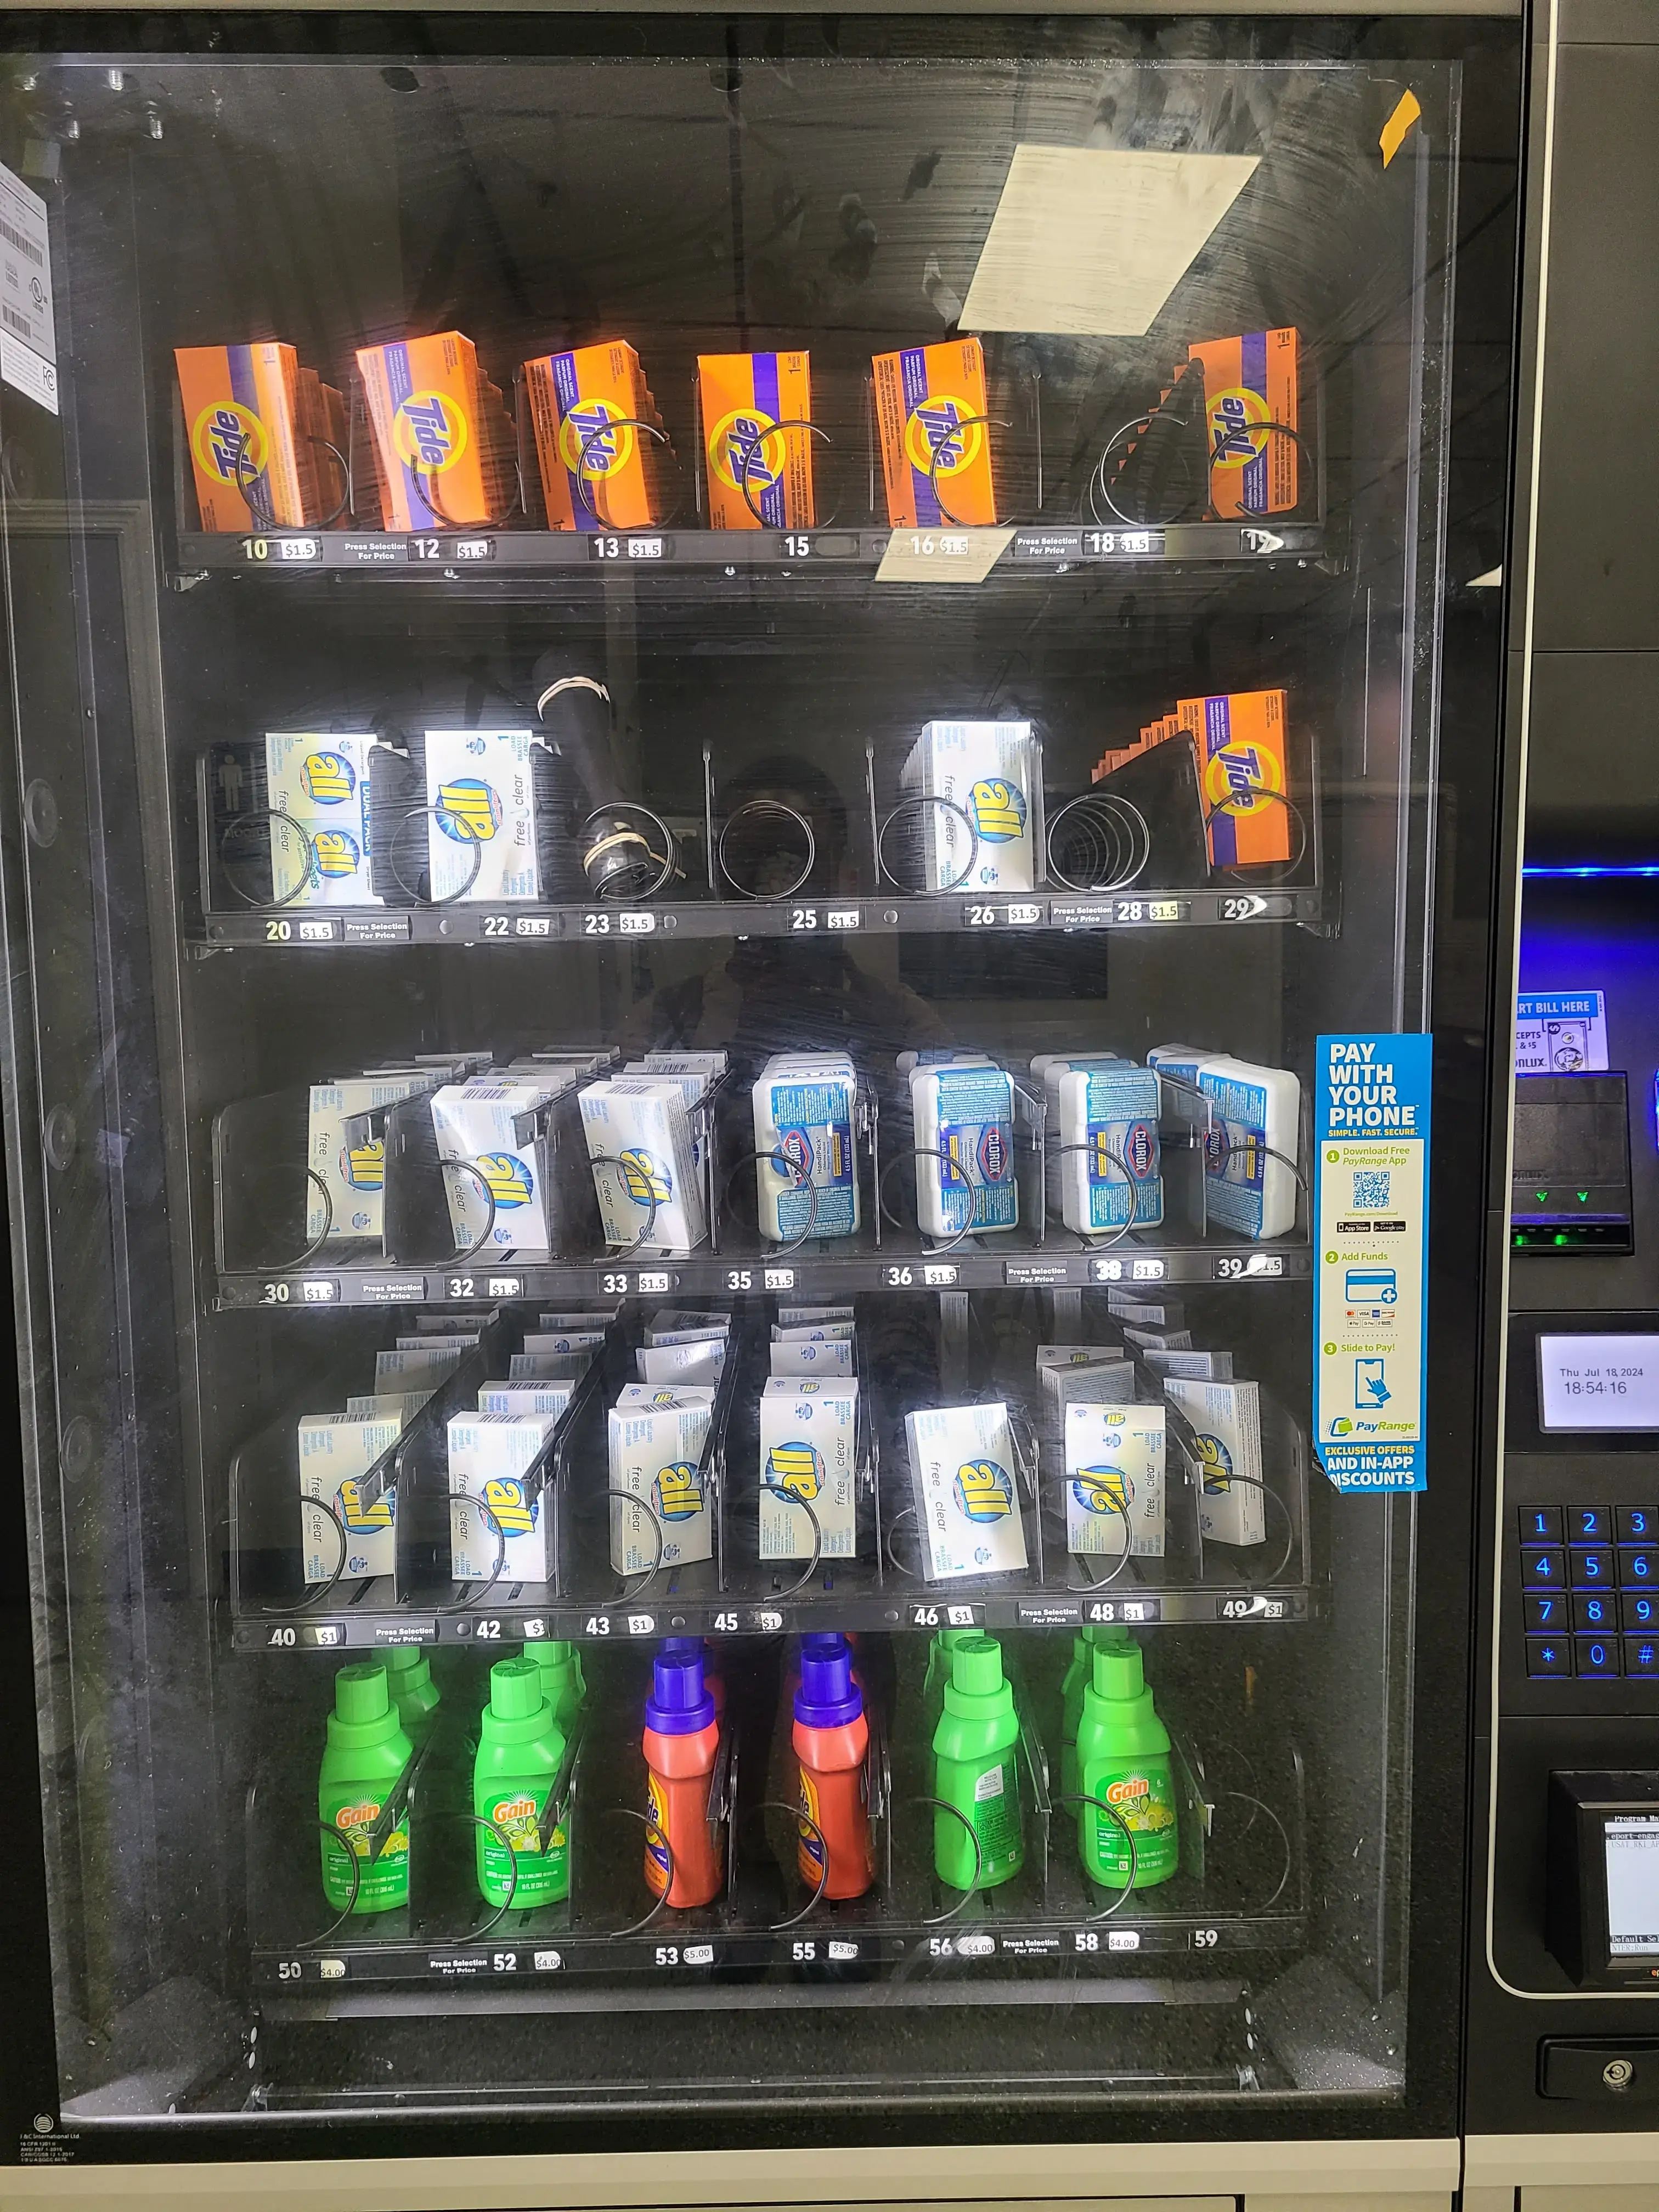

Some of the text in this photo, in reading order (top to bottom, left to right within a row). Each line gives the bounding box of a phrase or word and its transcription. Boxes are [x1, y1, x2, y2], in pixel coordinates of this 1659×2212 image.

[400, 397, 452, 466] Tide
[914, 400, 964, 469] Tide
[1214, 397, 1259, 461] Tide
[208, 410, 261, 479] Tide
[726, 416, 775, 484] Tide
[242, 539, 268, 560] 10
[285, 543, 313, 557] $1.5
[345, 542, 407, 551] Press Selection
[414, 539, 439, 559] 12
[458, 545, 486, 558] $1.5
[594, 538, 619, 557] 13
[633, 541, 659, 557] $1.5
[784, 537, 809, 556] 15
[910, 536, 934, 555] 16
[941, 538, 968, 554] $1.5
[1091, 533, 1115, 553] 18
[1120, 537, 1146, 551] $1.5
[358, 551, 395, 560] For Price
[306, 754, 353, 800] all
[973, 781, 1024, 838] all
[969, 905, 995, 925] 26
[1010, 906, 1037, 921] $1.5
[1118, 901, 1142, 921] 28
[1150, 904, 1177, 919] $1.5
[1224, 900, 1249, 919] 29
[484, 917, 509, 935] 22
[519, 921, 545, 934] $1.5
[585, 914, 610, 934] 23
[622, 916, 649, 931] $1.5
[793, 910, 817, 928] 25
[831, 914, 857, 928] $1.5
[266, 921, 291, 940] 20
[302, 927, 329, 939] $1.5
[1536, 1002, 1559, 1013] BILL
[1561, 1001, 1590, 1012] HERE
[1330, 1043, 1376, 1064] PAY
[1329, 1064, 1393, 1085] WITH
[1328, 1085, 1397, 1105] YOUR
[1328, 1128, 1360, 1137] SIMPLE.
[1362, 1128, 1382, 1137] FAST.
[988, 1134, 1001, 1175] CLOROX
[1135, 1131, 1147, 1171] CLOROX
[1330, 1152, 1336, 1161] 1
[1342, 1146, 1410, 1155] Download Free
[1342, 1156, 1407, 1167] PayRange App
[1329, 1254, 1335, 1262] 2
[1341, 1252, 1388, 1261] Add Funds
[888, 1267, 913, 1285] 36
[1096, 1262, 1122, 1280] 38
[1135, 1264, 1161, 1277] $1.5
[1217, 1259, 1243, 1277] 39
[603, 1274, 628, 1294] 33
[640, 1277, 665, 1290] $1.5
[727, 1271, 752, 1290] 35
[766, 1274, 792, 1288] $1.5
[929, 1270, 956, 1284] $1.5
[264, 1284, 290, 1302] 30
[306, 1287, 333, 1301] $1.5
[450, 1279, 474, 1297] 32
[492, 1283, 518, 1296] $1.5
[1328, 1345, 1334, 1353] 3
[1341, 1344, 1363, 1352] Slide
[1375, 1343, 1395, 1354] Pay!
[1560, 1368, 1644, 1378] Thu Jul 18, 2024
[1564, 1381, 1627, 1395] 18:54:16
[1356, 1421, 1415, 1433] PayRange
[1325, 1446, 1415, 1455] EXCLUSIVE OFFERS
[834, 1437, 845, 1506] free clear
[1328, 1456, 1413, 1471] AND IN-APP
[769, 1446, 819, 1501] all
[1329, 1471, 1415, 1487] DISCOUNTS
[658, 1466, 704, 1514] all
[930, 1462, 946, 1531] free clear
[959, 1464, 1012, 1515] all
[1076, 1469, 1127, 1512] all
[1536, 1514, 1547, 1532] 1
[1583, 1514, 1596, 1532] 2
[1632, 1513, 1644, 1531] 3
[1536, 1558, 1550, 1576] 4
[1586, 1558, 1598, 1576] 5
[1634, 1557, 1647, 1576] 6
[914, 1608, 939, 1625] 46
[955, 1610, 970, 1622] $1
[1090, 1604, 1114, 1621] 48
[1125, 1609, 1139, 1620] $1
[1222, 1601, 1245, 1618] 49
[1268, 1605, 1283, 1616] $1
[1538, 1602, 1552, 1620] 7
[1588, 1601, 1602, 1620] 8
[1637, 1601, 1650, 1620] 9
[477, 1621, 501, 1639] 42
[586, 1617, 610, 1634] 43
[633, 1619, 647, 1630] $1
[714, 1613, 738, 1630] 45
[762, 1617, 777, 1628] $1
[272, 1628, 296, 1646] 40
[320, 1631, 336, 1643] $1
[376, 1627, 434, 1636] Press Selection
[1591, 1645, 1603, 1664] 0
[1638, 1645, 1654, 1663] #
[1107, 1779, 1148, 1804] Gain
[337, 1804, 380, 1829] Gain
[493, 1800, 536, 1823] Gain
[1075, 1934, 1098, 1951] 58
[1110, 1938, 1135, 1948] $4.00
[1194, 1930, 1217, 1947] 59
[684, 1949, 709, 1959] $5.00
[792, 1943, 815, 1961] 55
[833, 1945, 858, 1955] $5.00
[929, 1939, 952, 1956] 56
[967, 1943, 993, 1954] $4.00
[493, 1954, 517, 1971] 52
[536, 1957, 561, 1968] $4.00
[655, 1948, 678, 1965] 53
[279, 1962, 302, 1979] 50
[321, 1968, 346, 1978] $4.00
